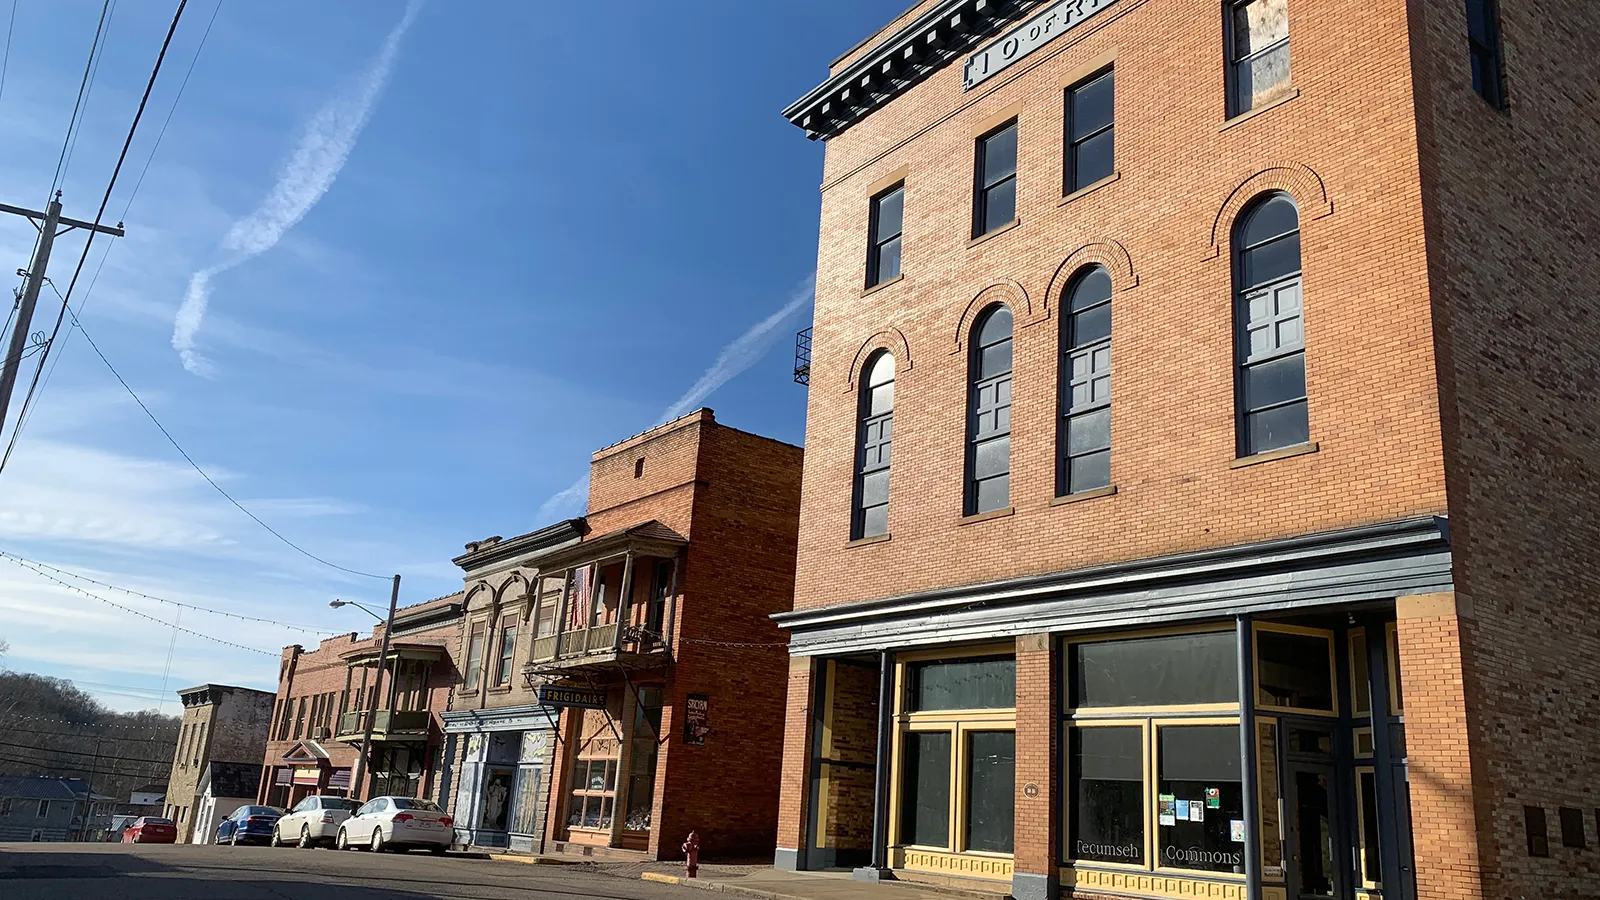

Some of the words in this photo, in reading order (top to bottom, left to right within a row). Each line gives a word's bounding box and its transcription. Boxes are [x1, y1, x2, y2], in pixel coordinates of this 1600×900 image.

[1030, 14, 1057, 41] OF
[1076, 839, 1139, 858] Tecumseh
[1165, 844, 1241, 865] Commons
